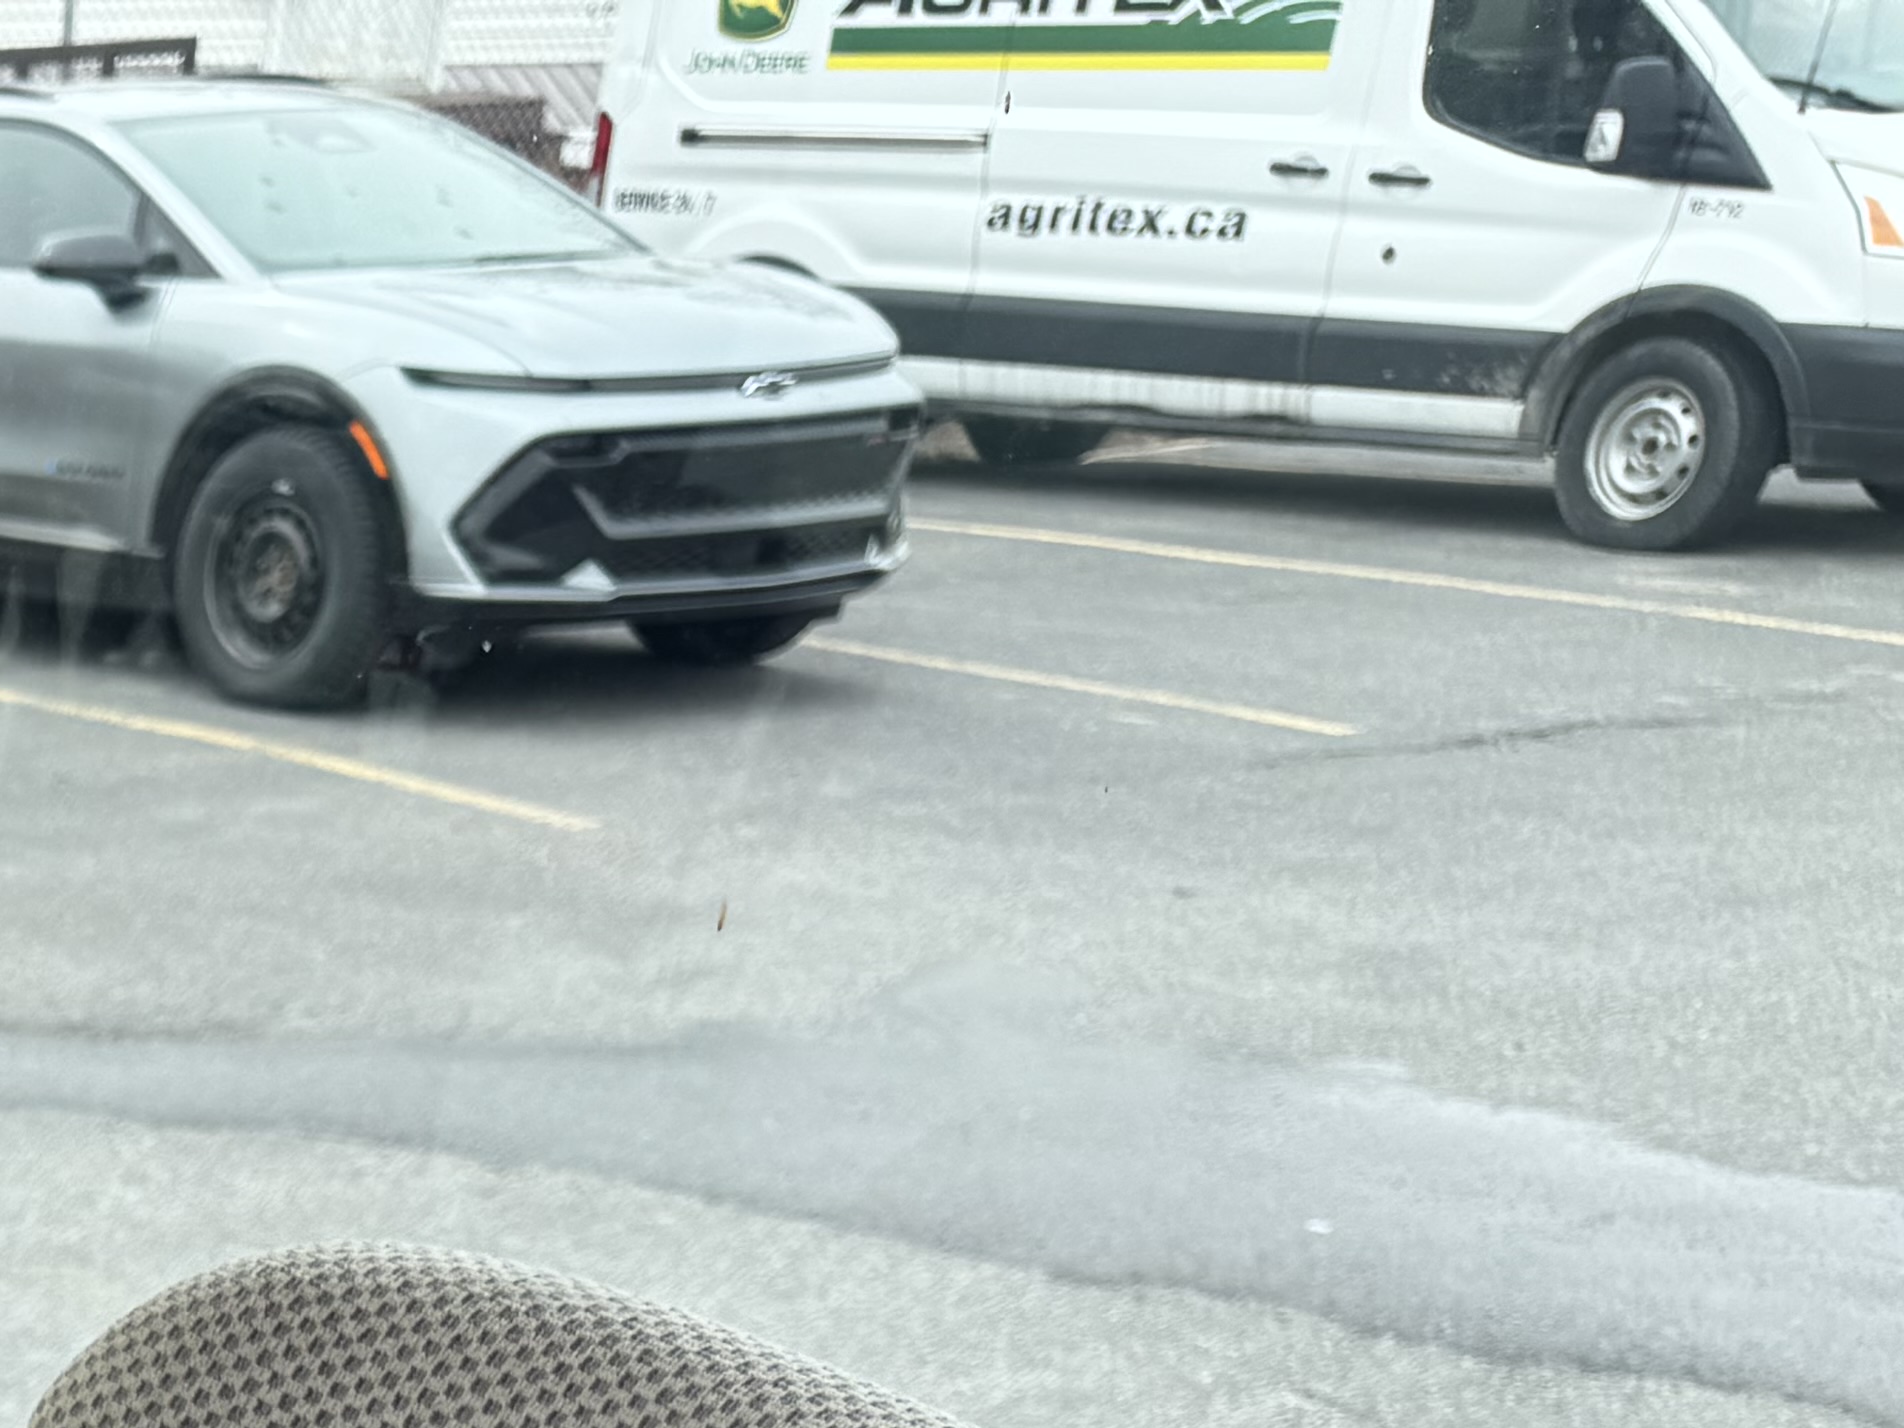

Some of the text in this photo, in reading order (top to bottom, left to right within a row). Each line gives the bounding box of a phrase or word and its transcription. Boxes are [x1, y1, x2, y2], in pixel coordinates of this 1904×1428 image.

[683, 48, 811, 75] JOHN DEERE
[985, 198, 1249, 243] agritex.ca
